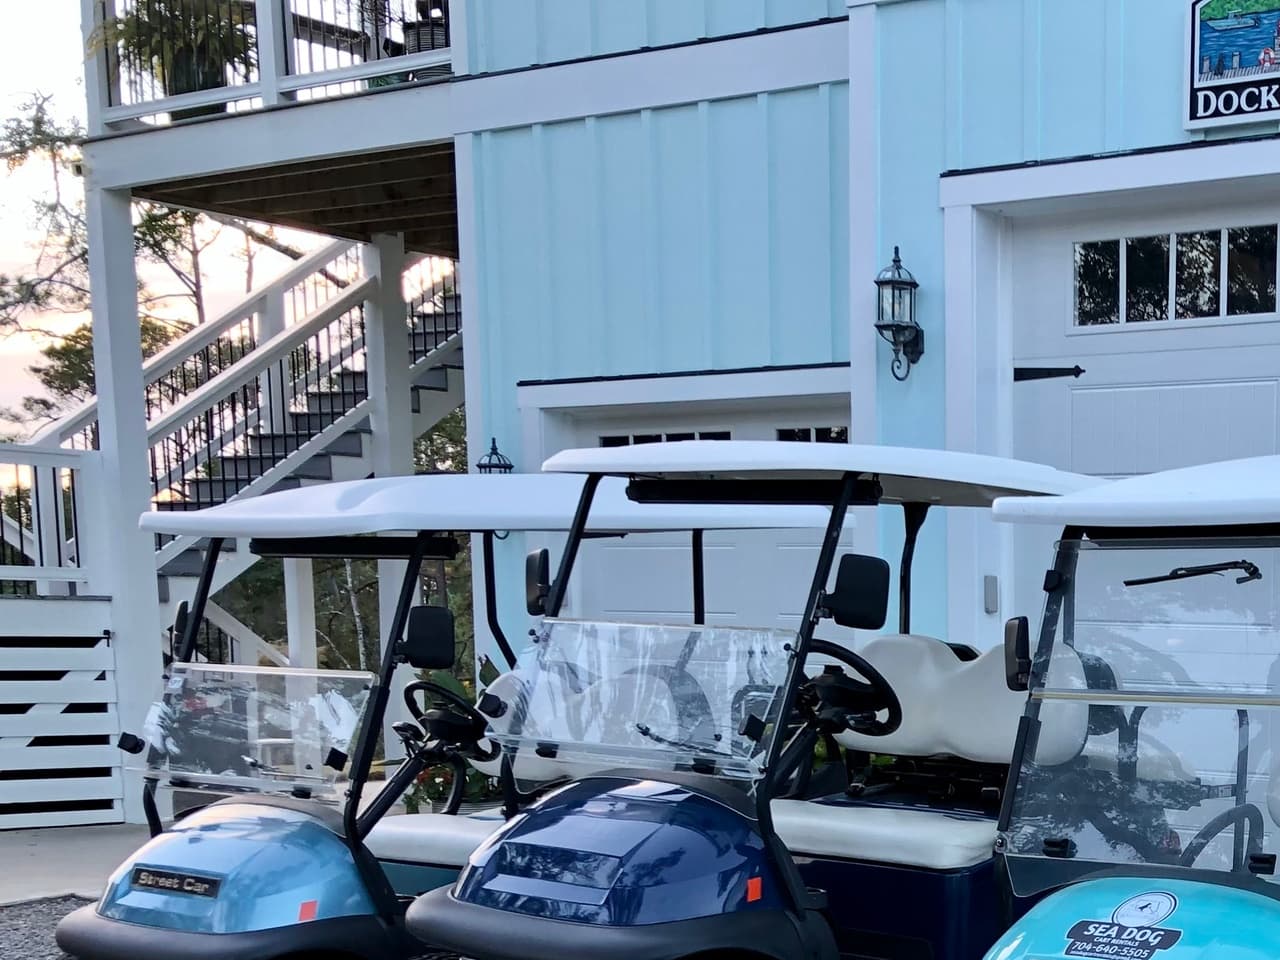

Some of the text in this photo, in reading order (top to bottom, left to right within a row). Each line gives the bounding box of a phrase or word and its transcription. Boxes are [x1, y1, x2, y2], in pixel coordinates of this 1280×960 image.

[1196, 84, 1280, 118] DOCK
[139, 872, 209, 893] Street Car
[1083, 924, 1165, 945] SEA DOG
[1111, 938, 1139, 947] RENTALS
[1071, 941, 1150, 958] 704-640-5505
